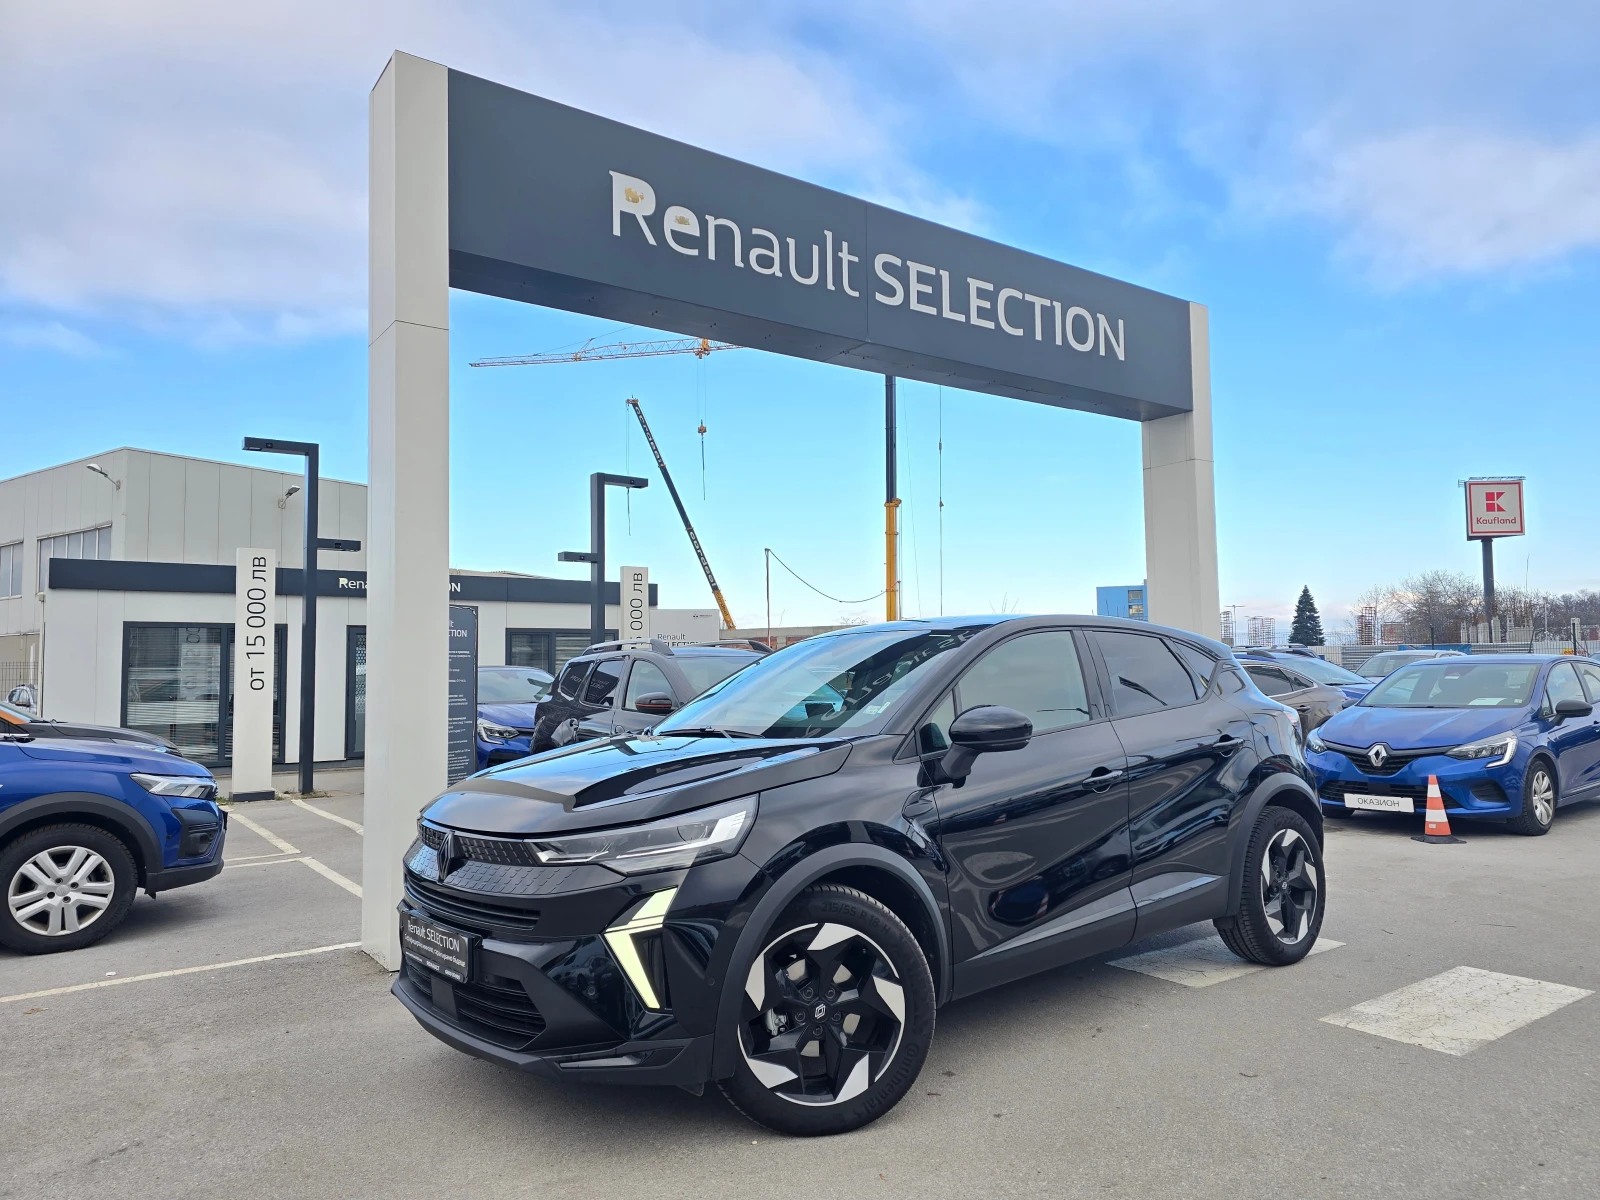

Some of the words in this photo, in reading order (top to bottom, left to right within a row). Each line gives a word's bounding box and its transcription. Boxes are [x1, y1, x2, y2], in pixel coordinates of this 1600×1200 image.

[609, 170, 859, 298] Renault
[874, 253, 1125, 361] SELECTION
[1476, 517, 1517, 525] Kaufland
[252, 556, 267, 582] ЛВ
[633, 572, 643, 594] ЛВ
[246, 587, 266, 629] 000
[630, 598, 643, 631] 000
[246, 635, 266, 660] 15
[657, 633, 686, 641] Renault
[250, 667, 265, 691] ОТ
[1357, 797, 1400, 807] ОКАЗИОН
[821, 902, 857, 917] 215/55
[859, 909, 868, 920] R
[869, 914, 880, 928] 18
[426, 928, 460, 953] SELECTION
[864, 1042, 920, 1114] Continental
